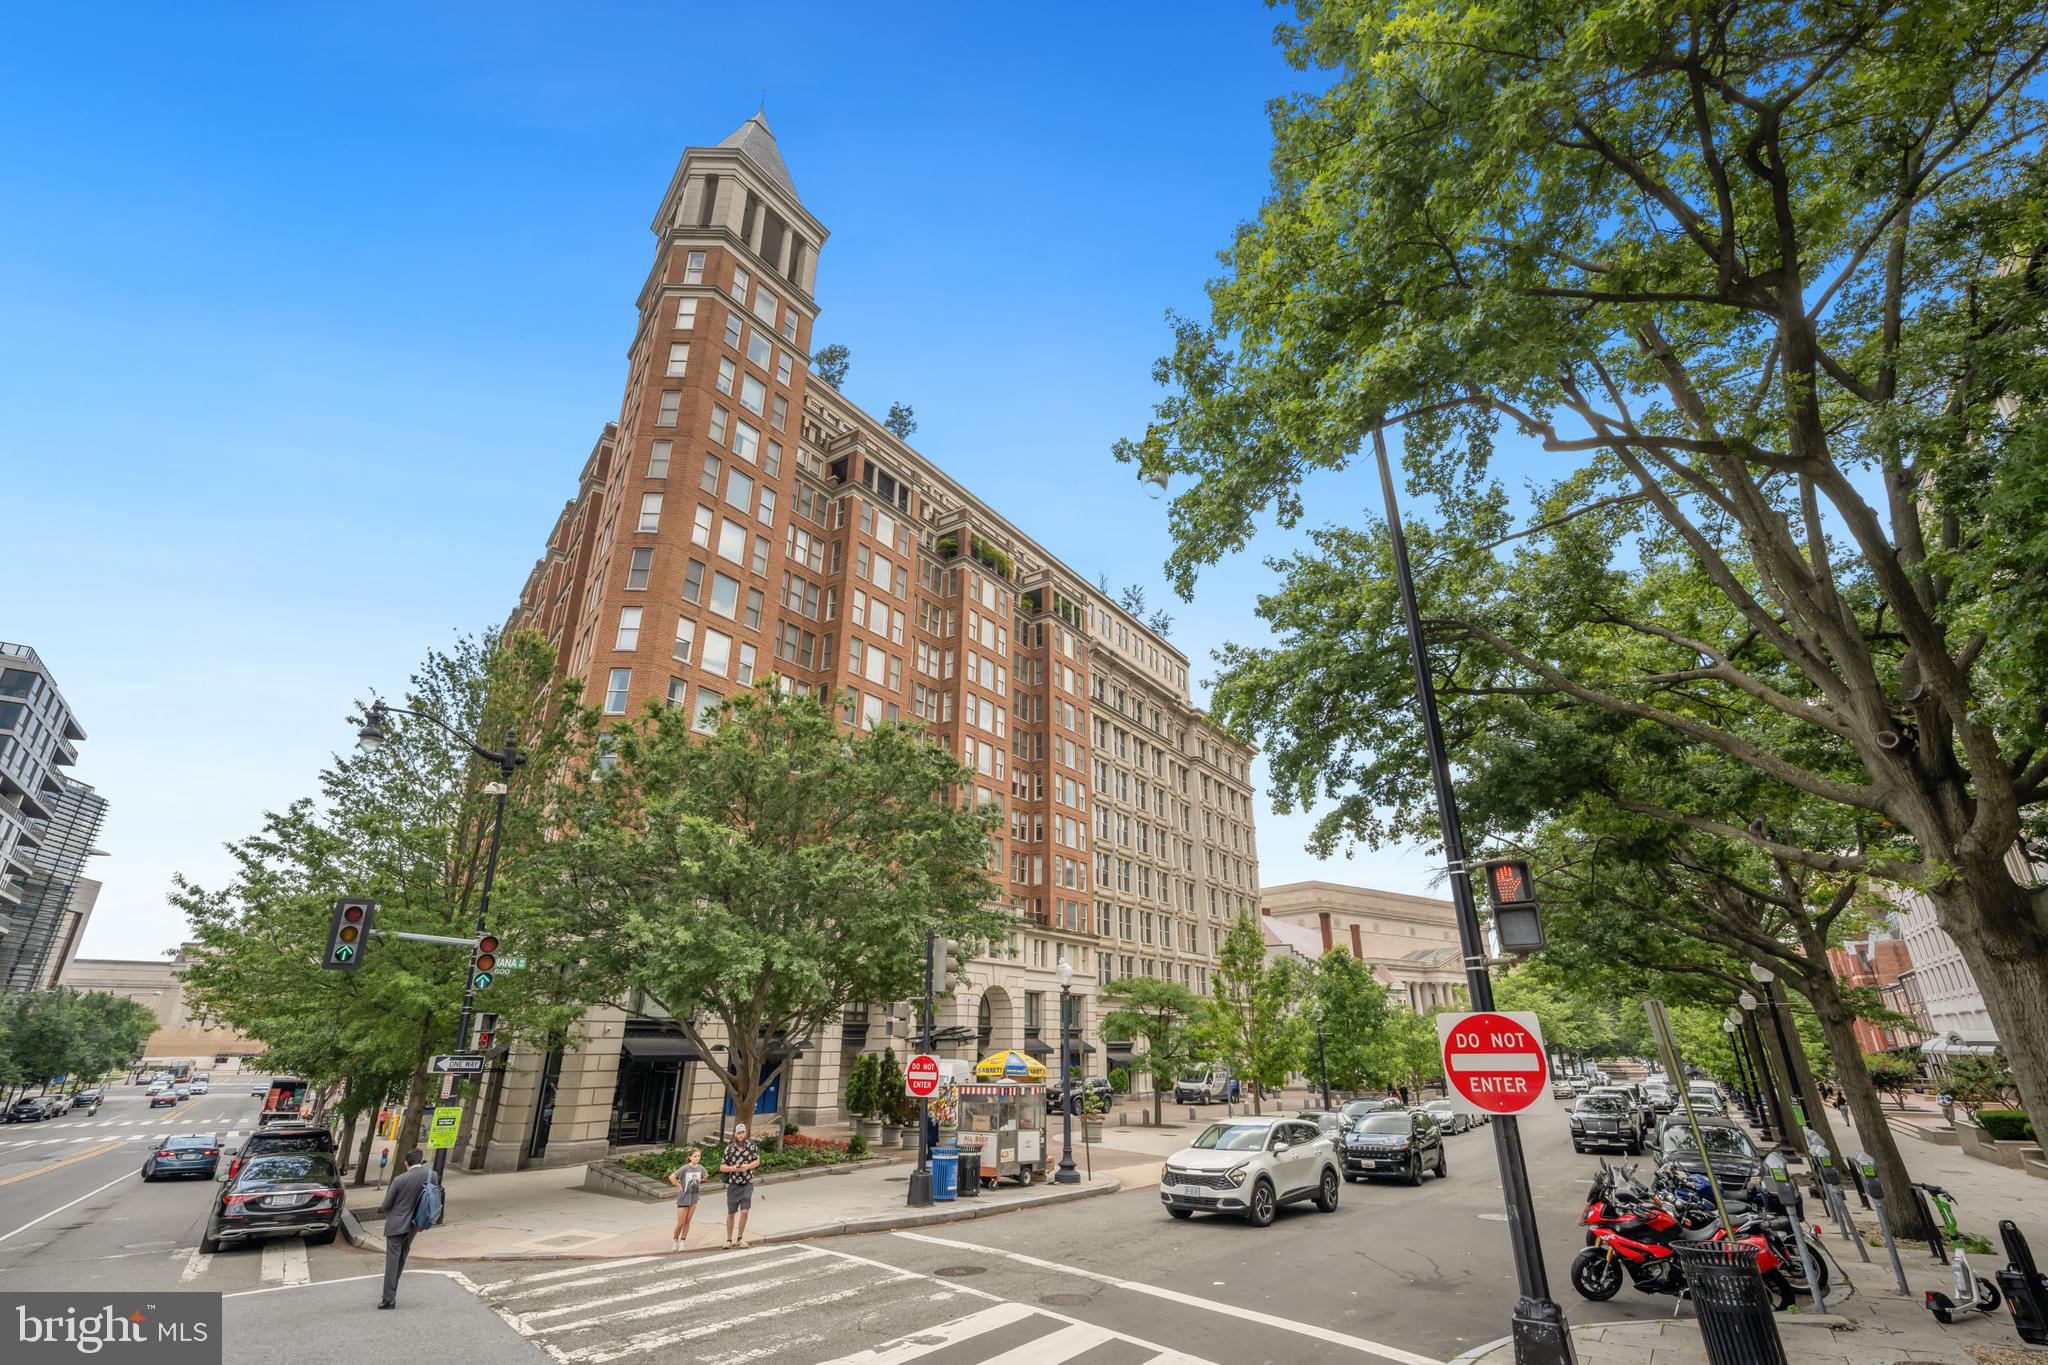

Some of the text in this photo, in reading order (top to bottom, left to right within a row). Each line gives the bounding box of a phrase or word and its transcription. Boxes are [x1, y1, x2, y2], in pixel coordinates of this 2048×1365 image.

[1455, 1032, 1525, 1048] DO NOT
[465, 1060, 479, 1068] WAY
[913, 1081, 932, 1089] ENTER
[1469, 1077, 1528, 1093] ENTER
